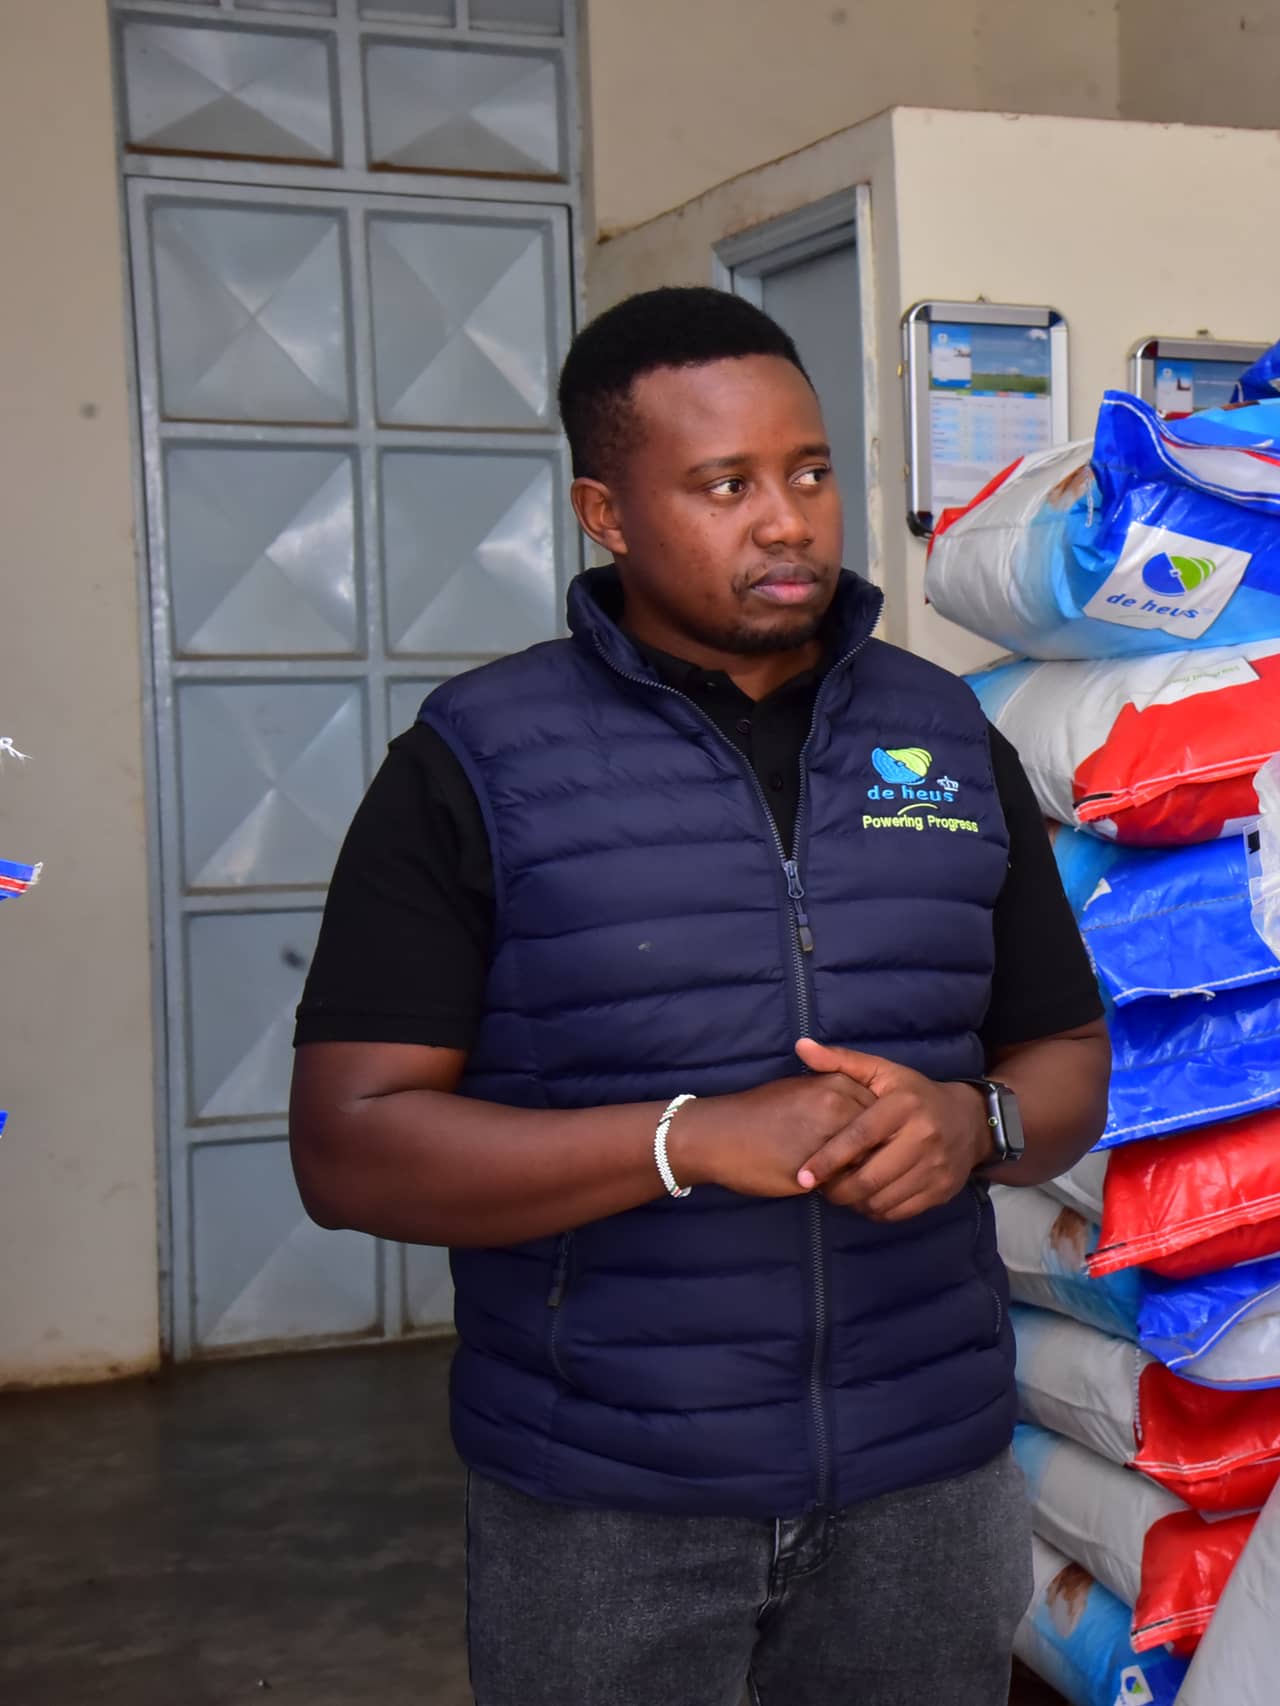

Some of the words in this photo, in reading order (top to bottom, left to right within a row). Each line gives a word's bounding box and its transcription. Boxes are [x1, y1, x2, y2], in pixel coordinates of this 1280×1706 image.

[1106, 593, 1136, 607] de
[1140, 600, 1199, 619] heus
[867, 785, 895, 800] de
[901, 785, 954, 802] heus
[863, 814, 924, 831] Powering
[927, 815, 979, 832] Progress
